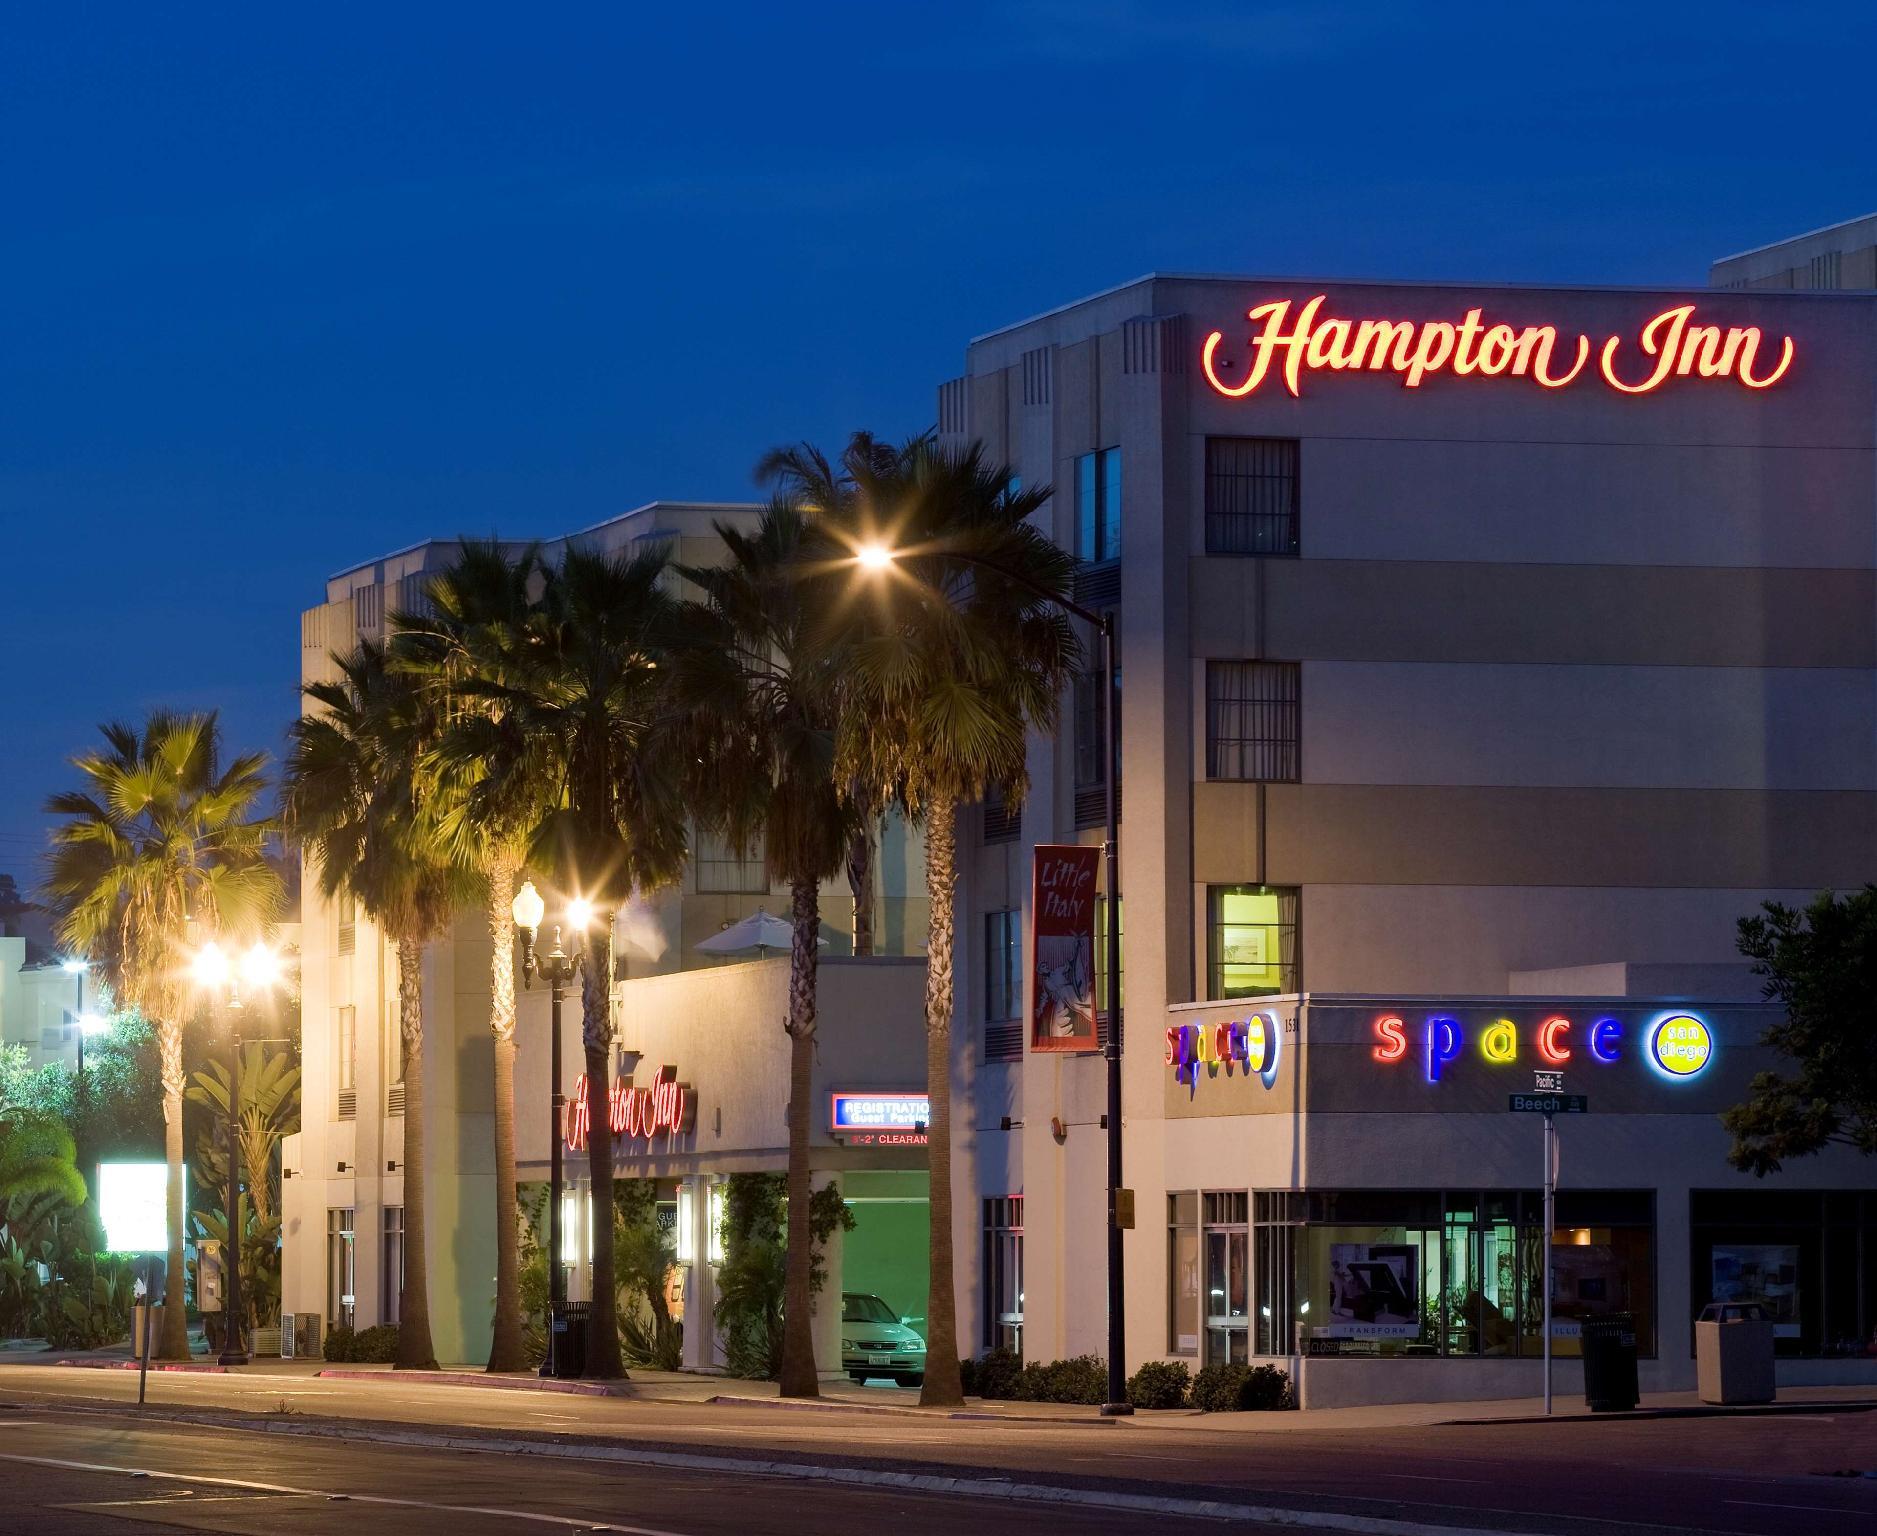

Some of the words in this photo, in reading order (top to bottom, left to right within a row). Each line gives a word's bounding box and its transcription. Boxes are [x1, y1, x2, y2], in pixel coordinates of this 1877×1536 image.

[1202, 294, 1591, 398] Hampton
[1600, 304, 1795, 393] Inn
[1041, 856, 1090, 888] Little
[1045, 887, 1085, 926] Italy
[1669, 1027, 1699, 1039] san
[1374, 1016, 1622, 1081] space
[1660, 1043, 1707, 1060] diego
[1535, 1074, 1555, 1089] Pacific
[642, 1064, 684, 1138] Inn
[845, 1102, 930, 1113] REGISTRATIO
[1514, 1096, 1560, 1110] Beech
[878, 1135, 928, 1144] CLEARAN
